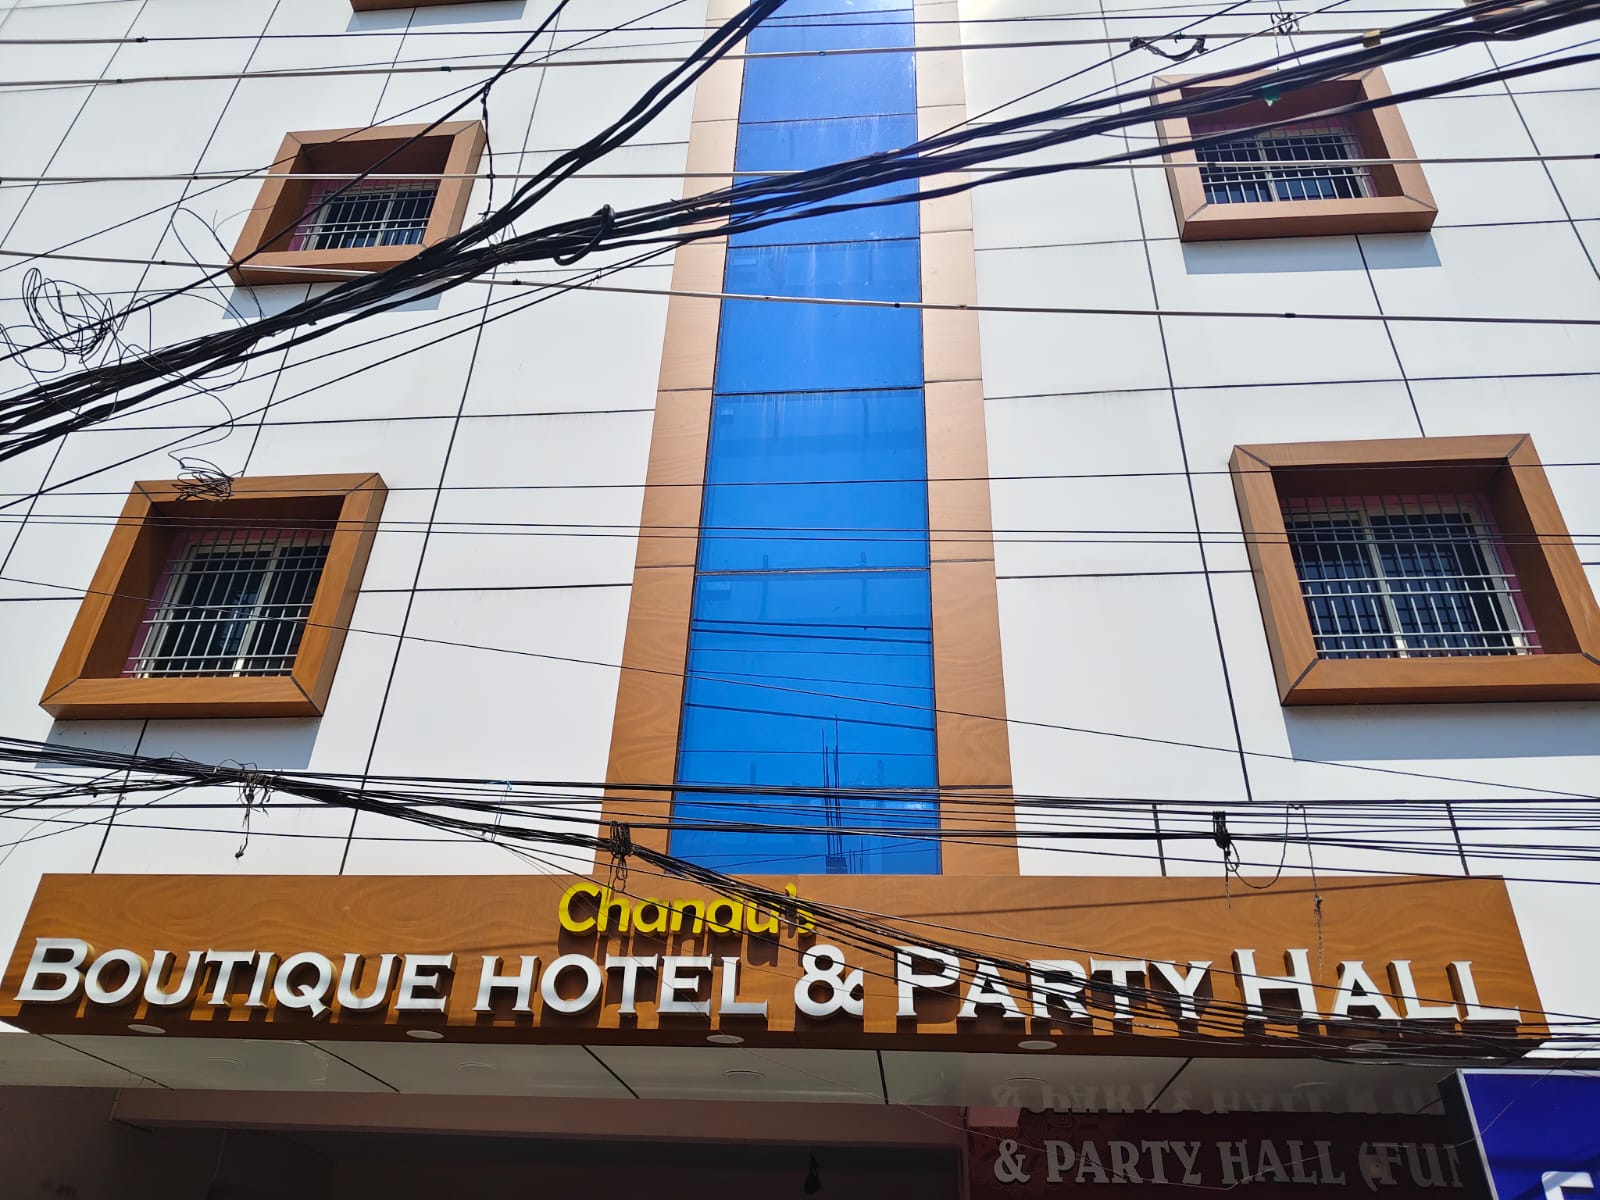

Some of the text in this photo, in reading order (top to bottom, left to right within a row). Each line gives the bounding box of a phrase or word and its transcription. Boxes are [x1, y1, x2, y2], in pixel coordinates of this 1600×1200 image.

[13, 937, 1522, 1020] BOUTIQUE HOTEL & PARTY HALL
[994, 1138, 1031, 1183] &
[1043, 1139, 1201, 1184] PARTY
[1216, 1138, 1346, 1186] HALL
